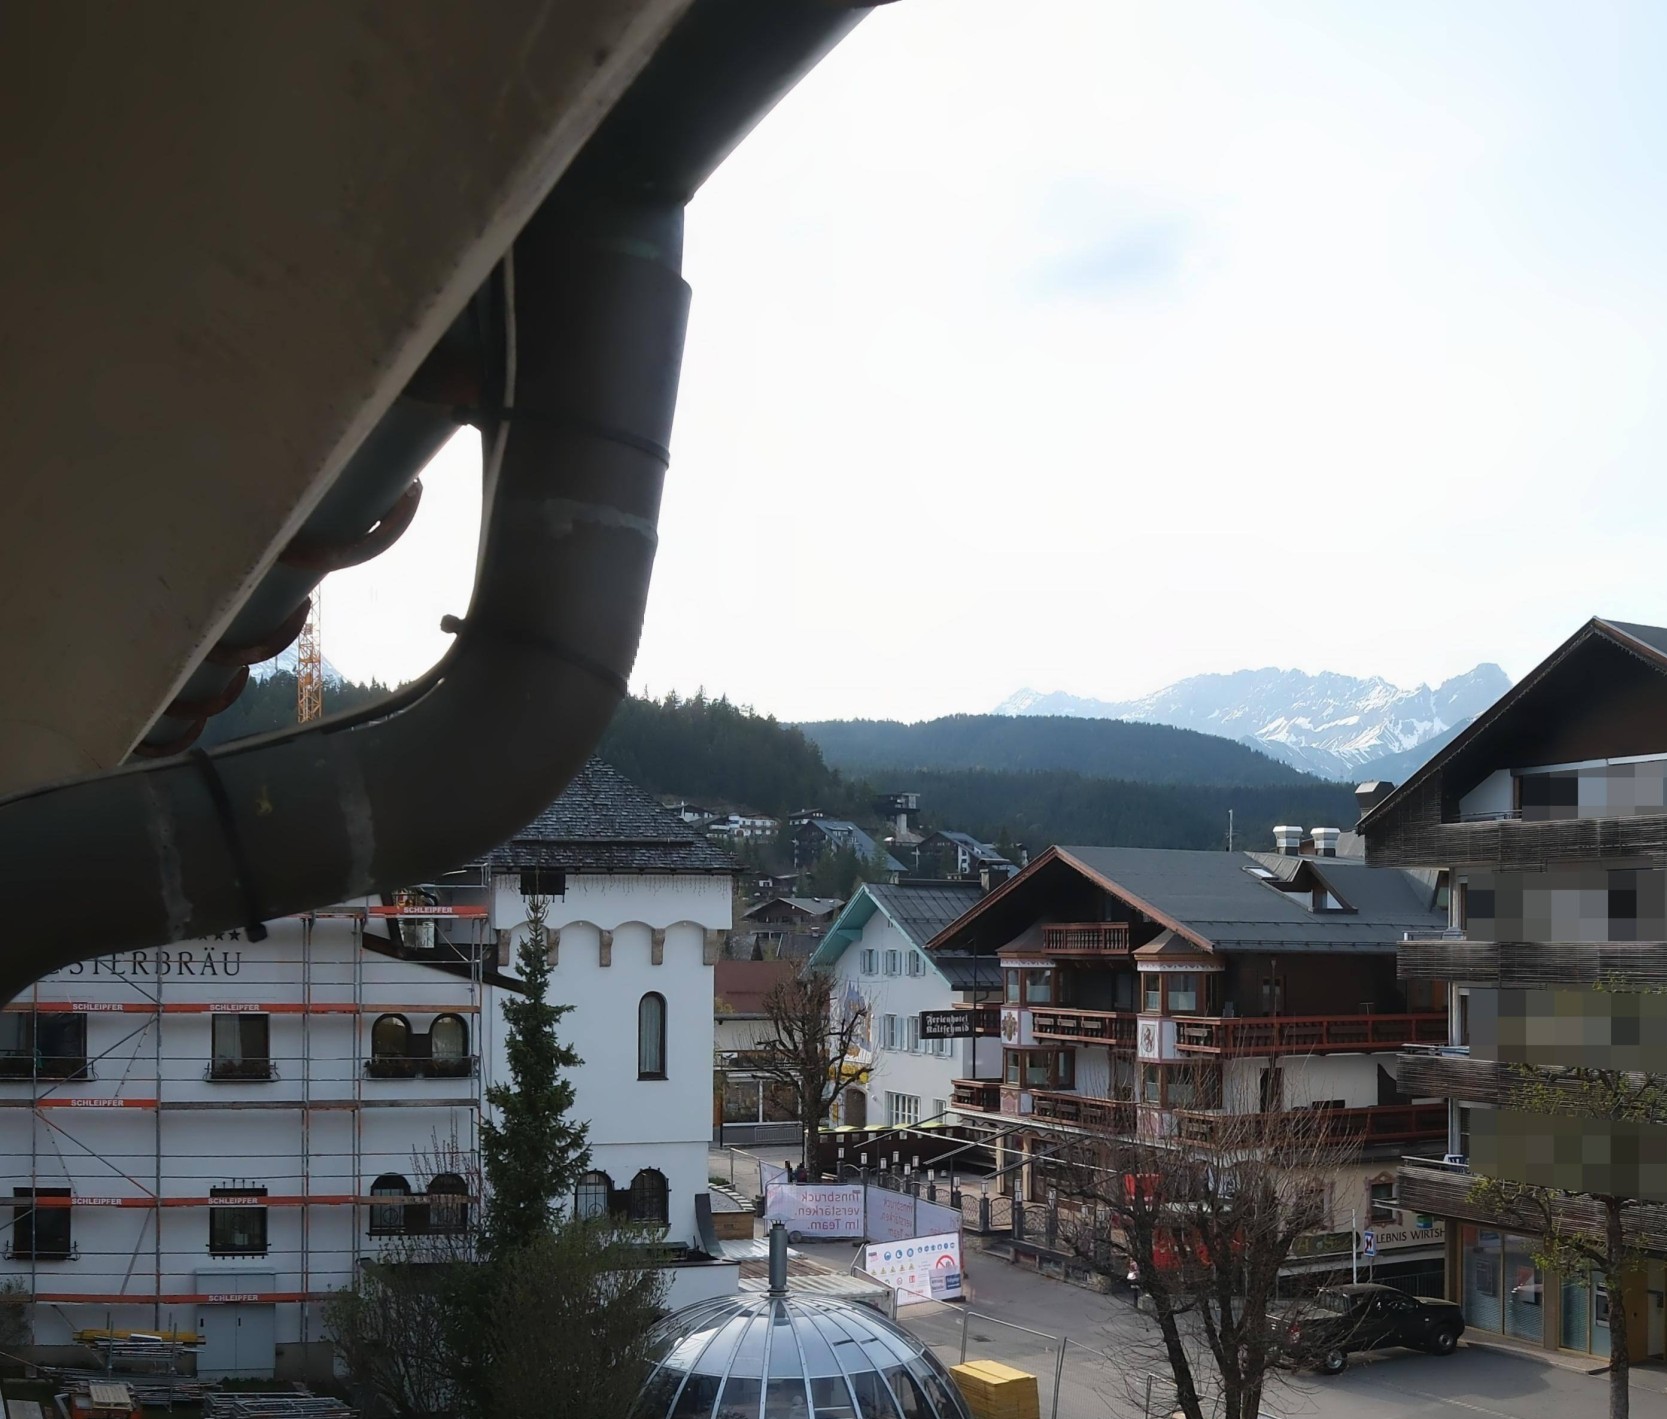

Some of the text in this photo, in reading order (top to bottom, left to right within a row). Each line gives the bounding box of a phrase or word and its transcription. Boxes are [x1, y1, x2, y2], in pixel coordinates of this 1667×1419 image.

[403, 906, 453, 914] SCHLEIPFER
[49, 947, 242, 976] STERBRÄU
[72, 1003, 123, 1011] SCHLEIPFER
[71, 1099, 124, 1107] SCHLEIPFER
[1376, 1230, 1407, 1243] LEBNIS
